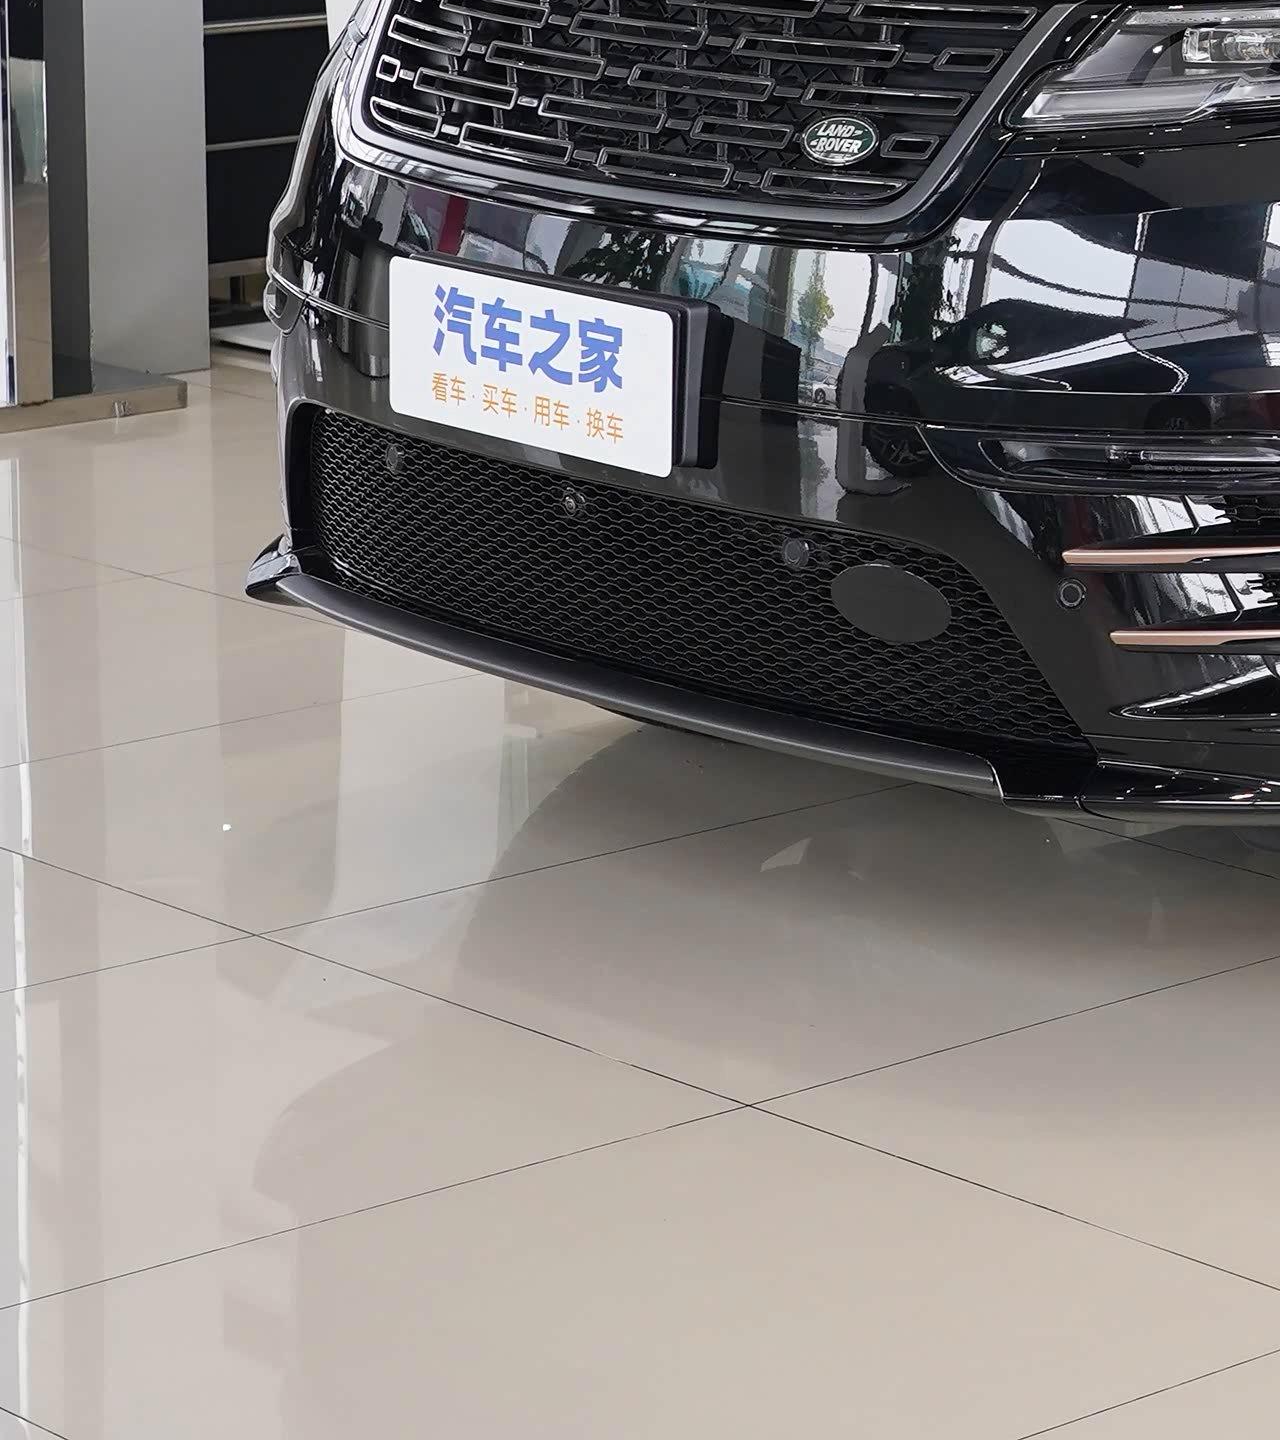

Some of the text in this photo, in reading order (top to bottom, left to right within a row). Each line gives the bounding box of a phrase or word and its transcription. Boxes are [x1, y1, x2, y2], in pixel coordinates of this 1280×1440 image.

[816, 123, 856, 138] LAND
[815, 137, 863, 154] ROVER
[432, 283, 624, 394] 汽车之家
